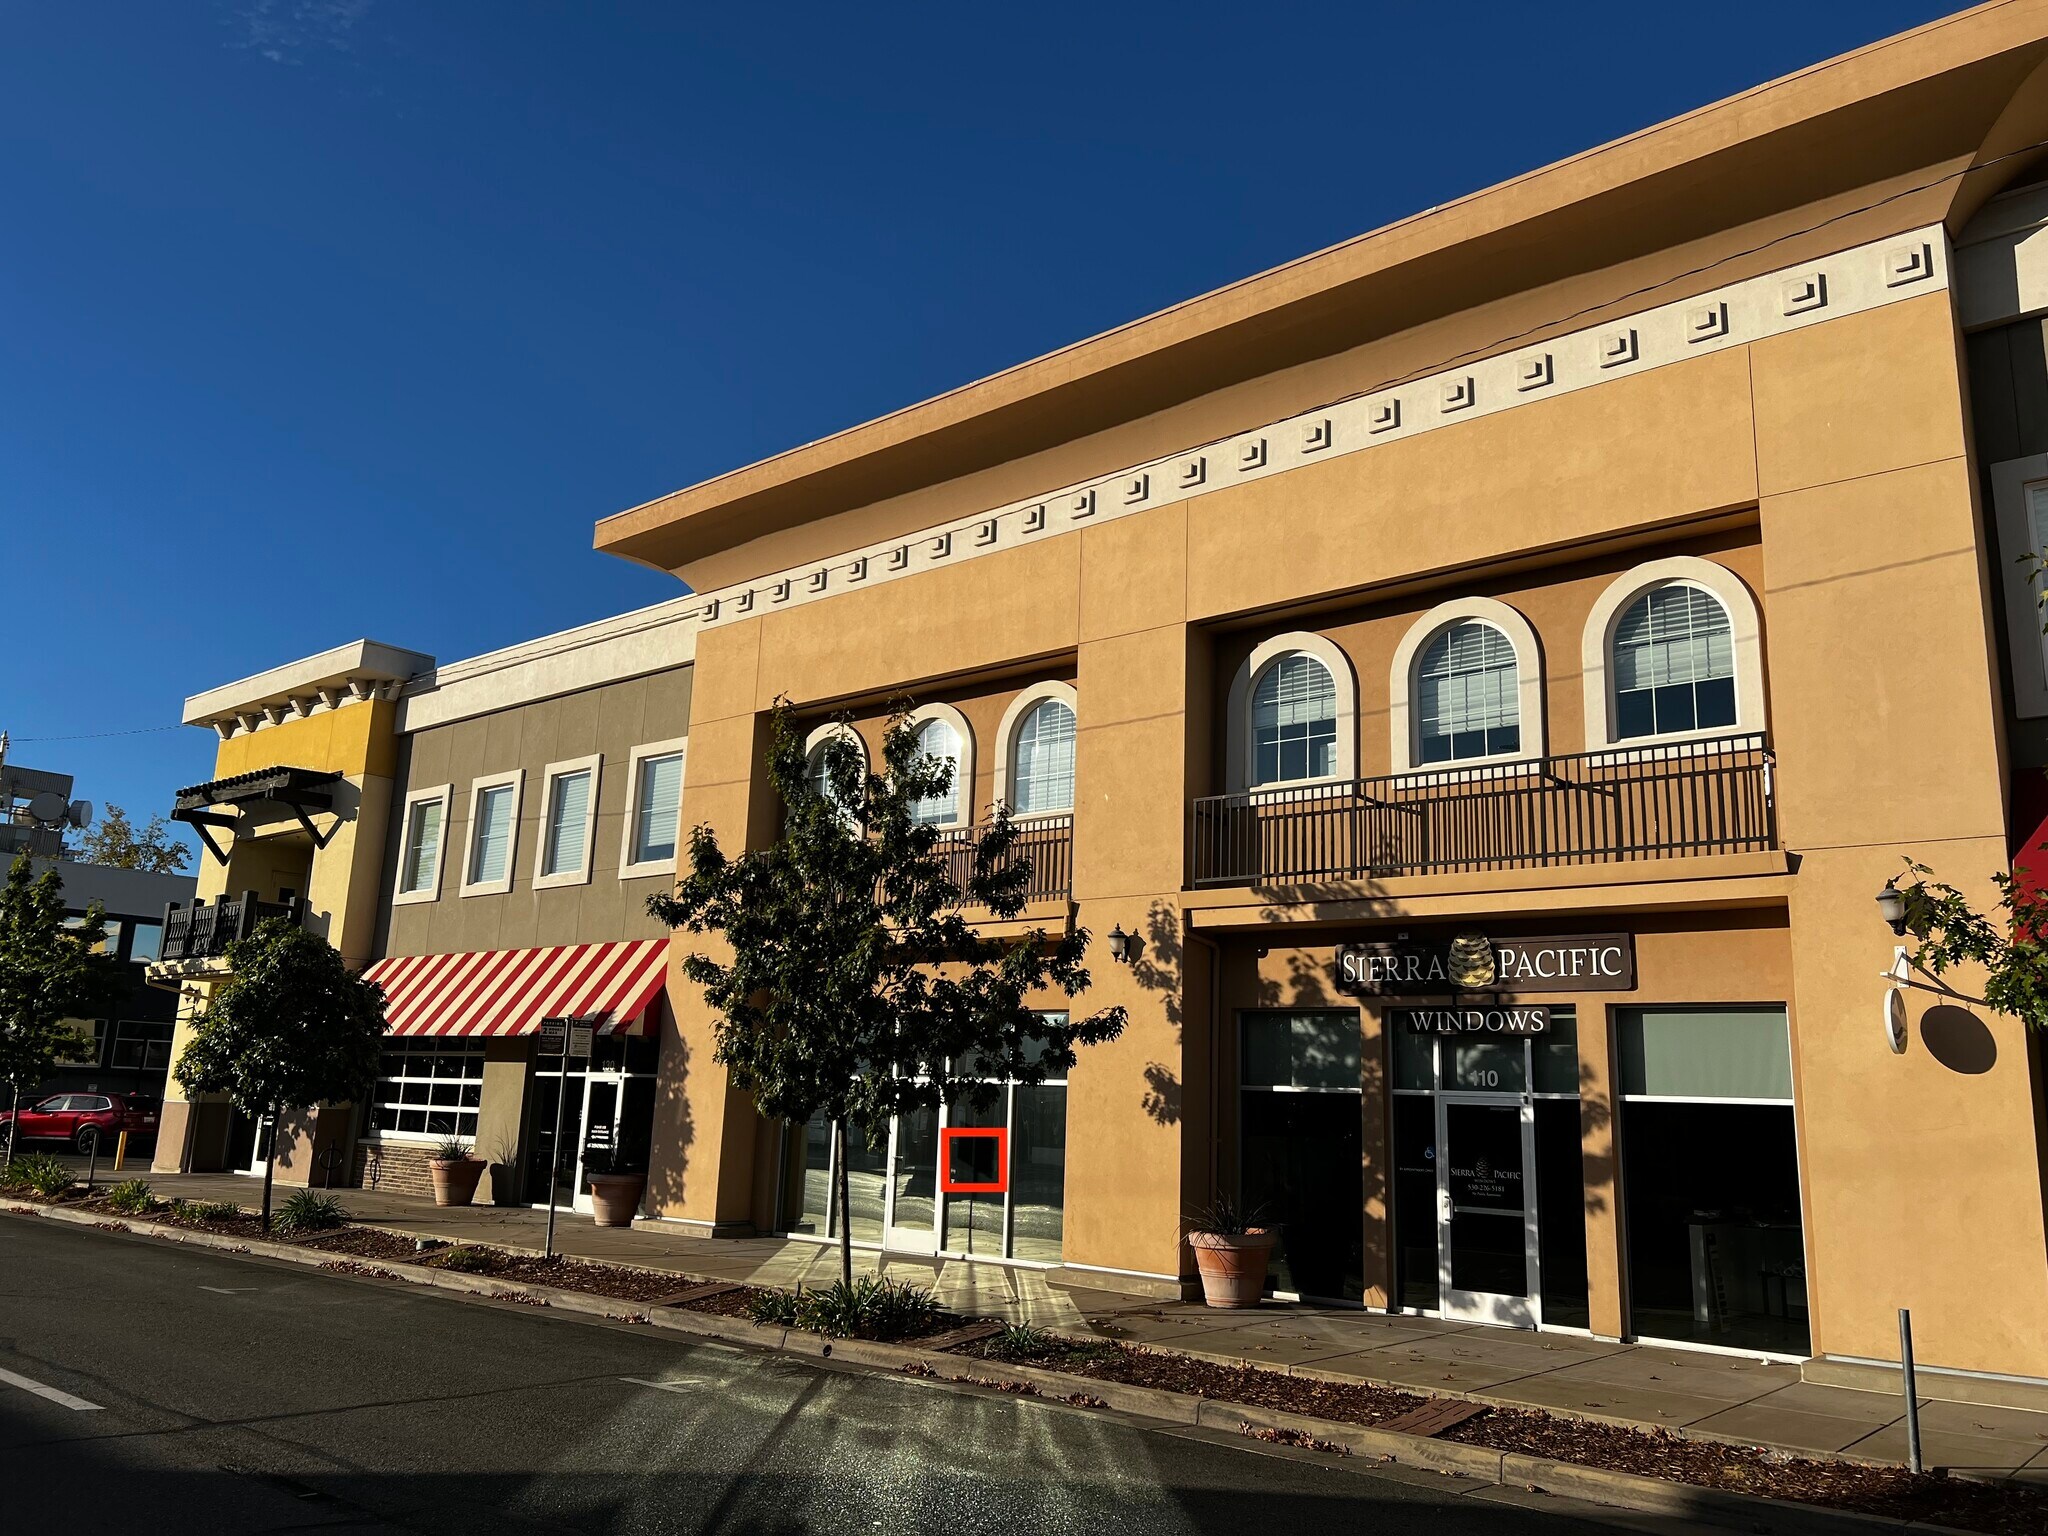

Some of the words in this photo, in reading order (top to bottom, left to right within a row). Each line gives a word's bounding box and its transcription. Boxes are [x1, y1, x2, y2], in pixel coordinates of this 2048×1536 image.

[1342, 955, 1447, 983] SIERRA
[1498, 947, 1622, 978] PACIFIC
[1410, 1010, 1544, 1032] WINDOWS
[1470, 1070, 1498, 1087] 110
[1451, 1167, 1475, 1177] SIERRA
[1494, 1170, 1521, 1180] PACIFIC
